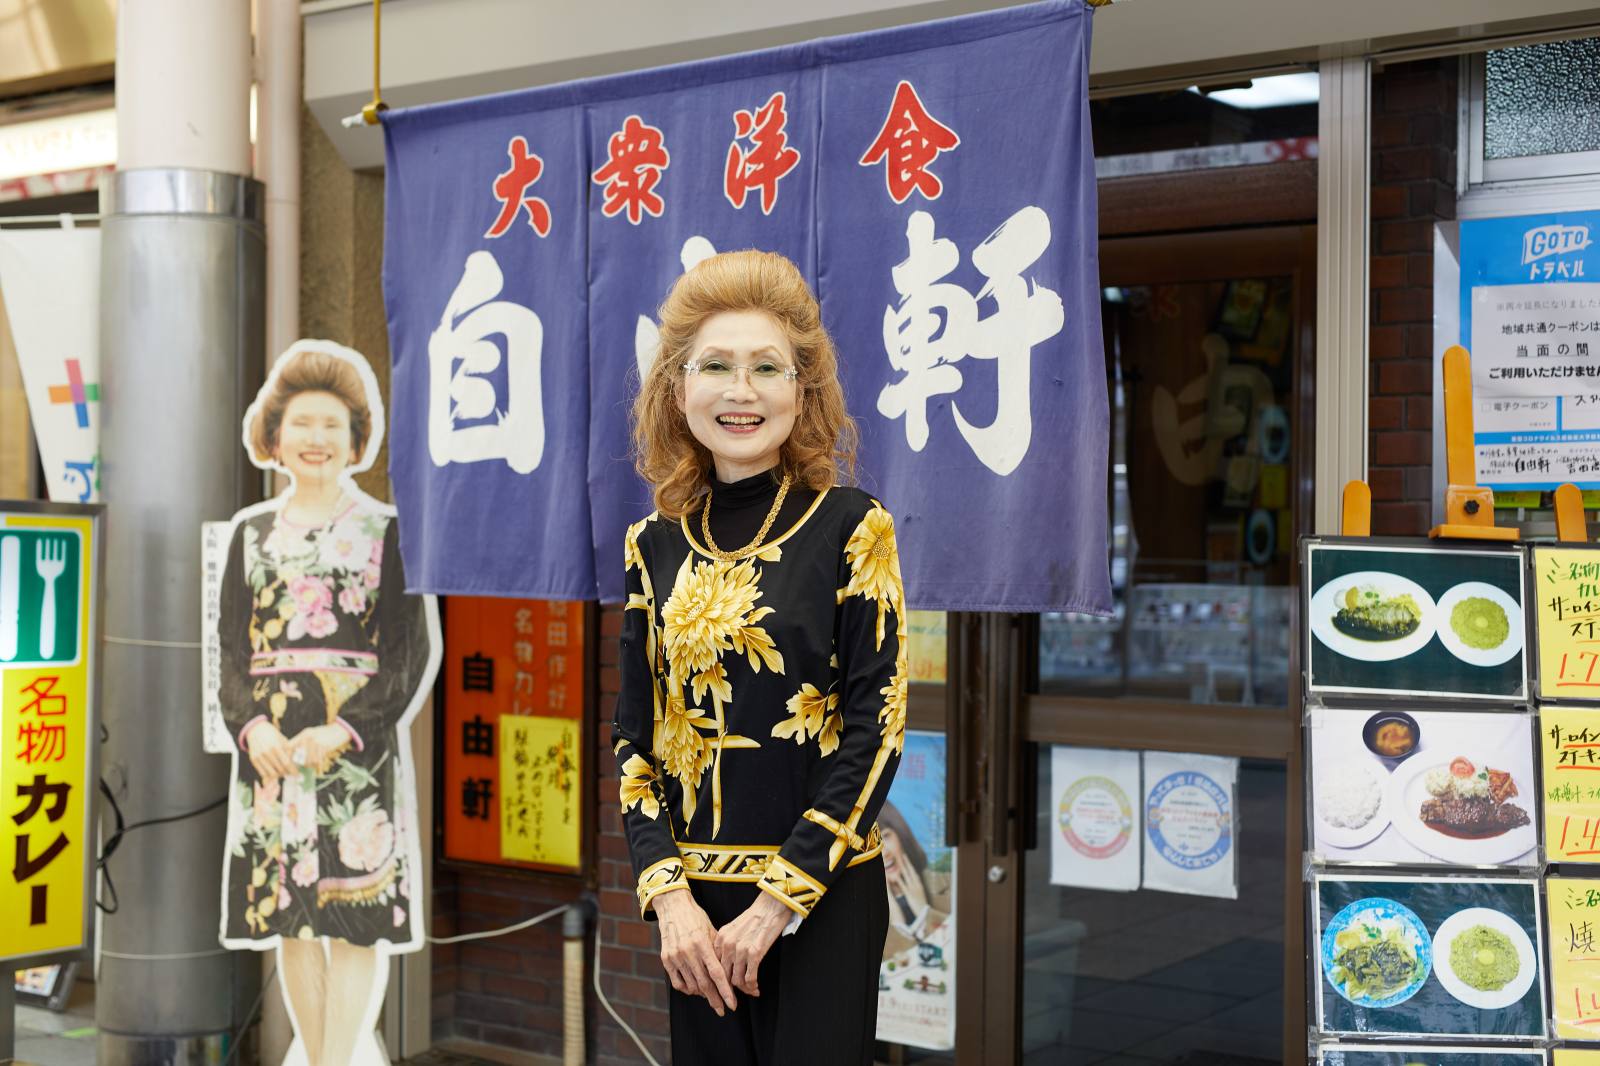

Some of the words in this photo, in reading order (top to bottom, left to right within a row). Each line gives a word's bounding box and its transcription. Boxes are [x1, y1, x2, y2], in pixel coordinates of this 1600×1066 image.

[1529, 260, 1585, 281] トラベル
[428, 205, 1065, 476] 自軒
[1493, 401, 1549, 412] 電子クーポン
[462, 651, 494, 822] 自由軒
